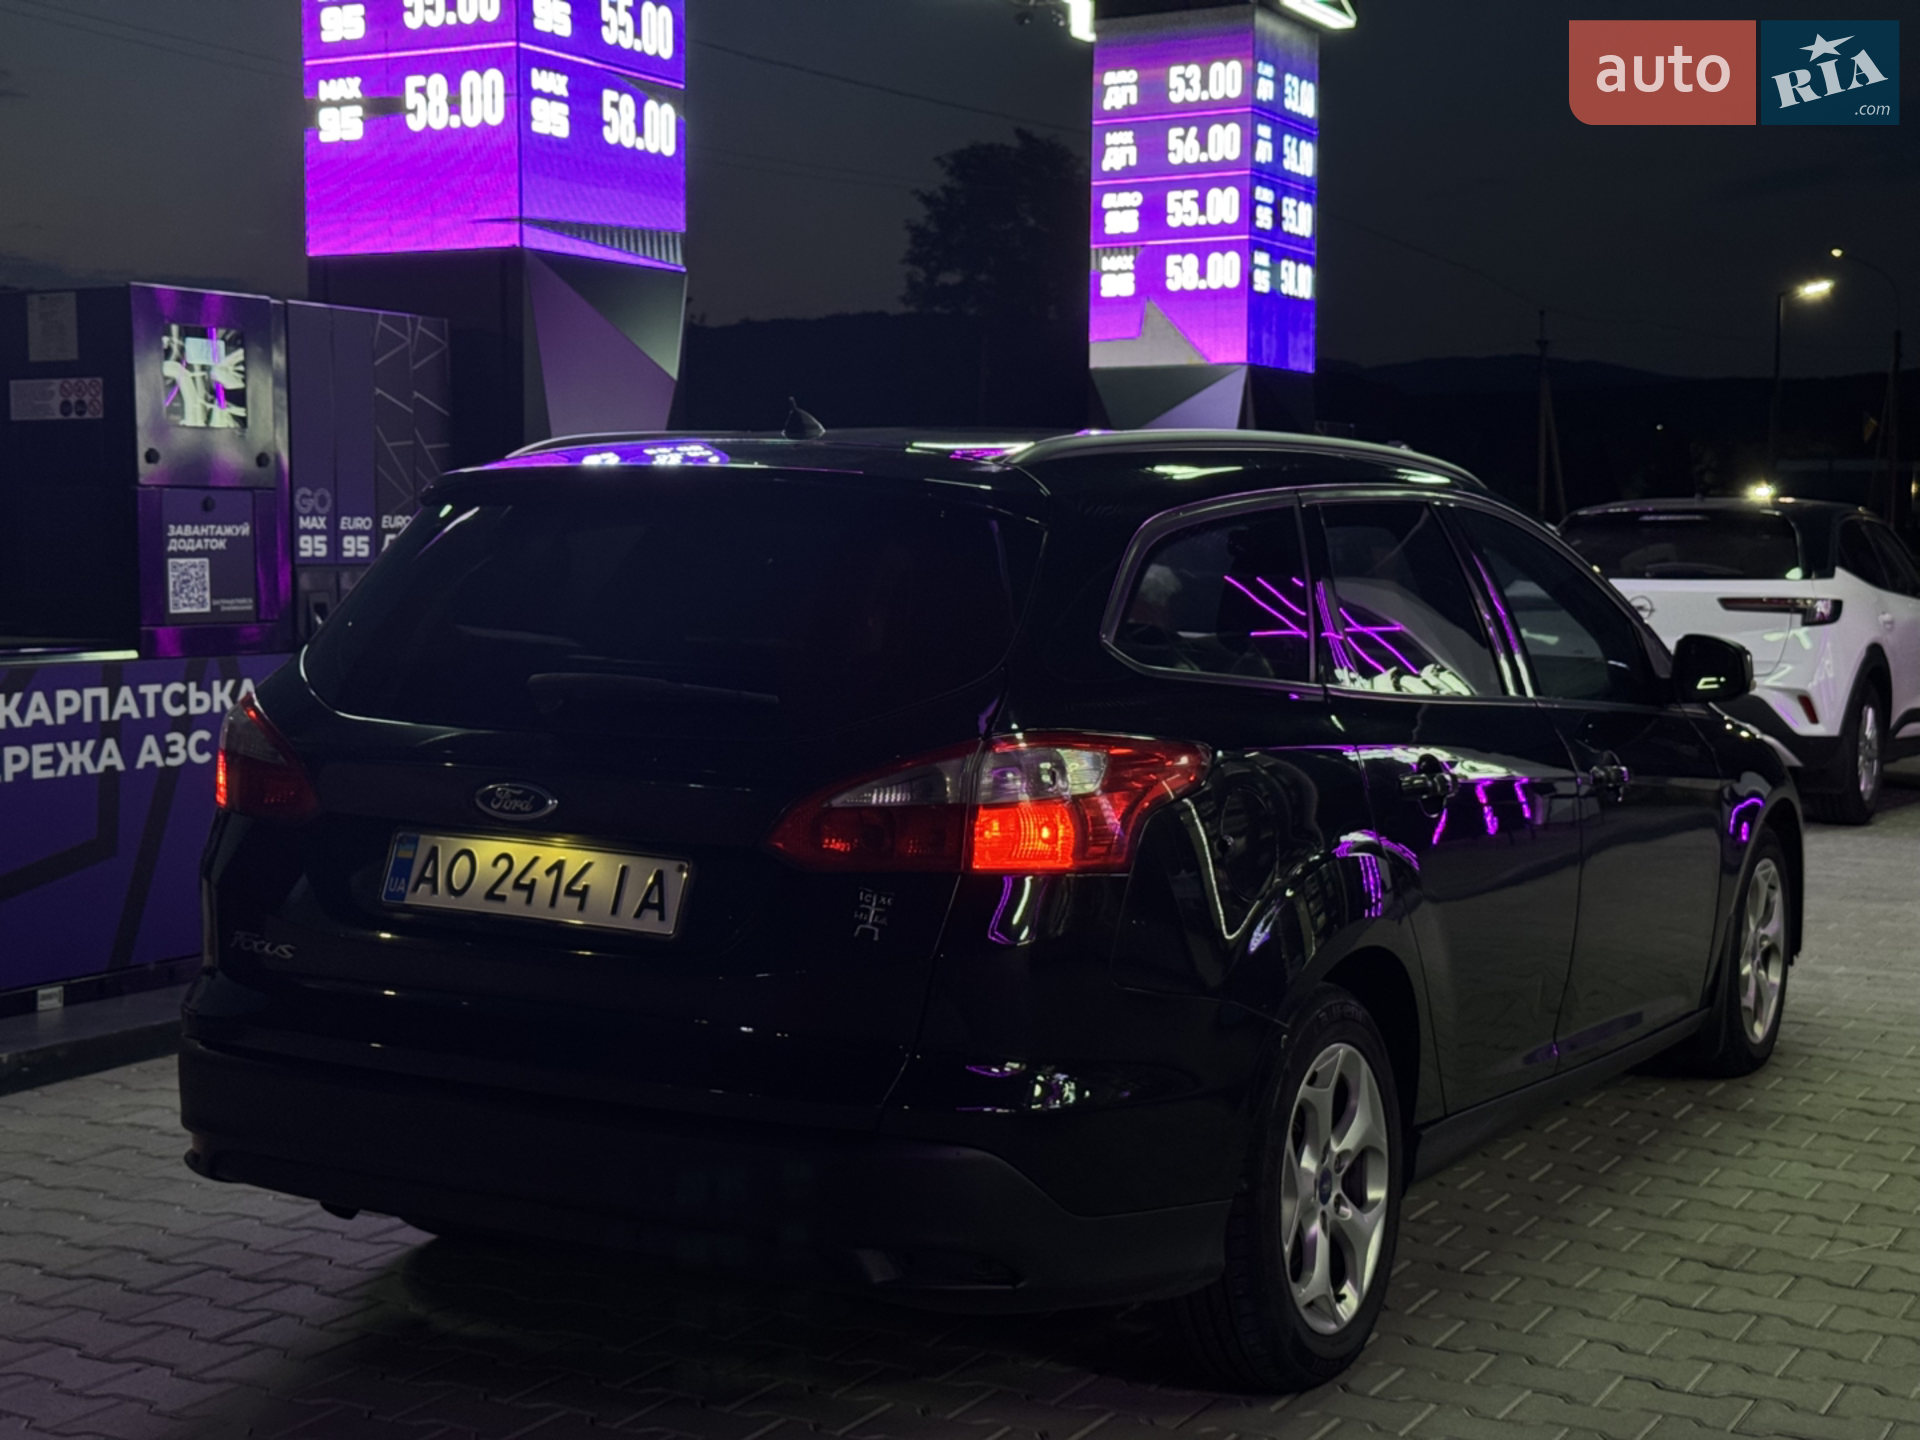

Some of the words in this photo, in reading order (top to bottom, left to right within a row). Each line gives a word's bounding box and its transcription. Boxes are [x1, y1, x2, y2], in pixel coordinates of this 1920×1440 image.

[320, 4, 365, 42] 95
[600, 0, 674, 59] 55.00
[319, 77, 362, 102] MAX
[405, 68, 504, 131] 58.00
[531, 68, 568, 97] MAX
[1168, 60, 1242, 103] 53.00
[318, 105, 364, 142] 95
[531, 97, 570, 138] 95
[602, 89, 676, 157] 58.00
[1167, 122, 1241, 165] 56.00
[1166, 186, 1239, 228] 55.00
[1165, 251, 1240, 292] 58.00
[295, 487, 332, 515] GO
[167, 522, 250, 537] ЗАВАНТАЖУЙ
[298, 516, 327, 530] MAX
[340, 516, 373, 530] EURO
[167, 538, 227, 552] ДОДАТОК
[298, 535, 328, 557] 95
[342, 535, 370, 557] 95
[135, 729, 212, 770] АЗС
[490, 787, 535, 813] Ford
[388, 876, 406, 894] UA
[411, 845, 477, 898] AO
[484, 852, 595, 912] 2414
[610, 864, 666, 921] IA
